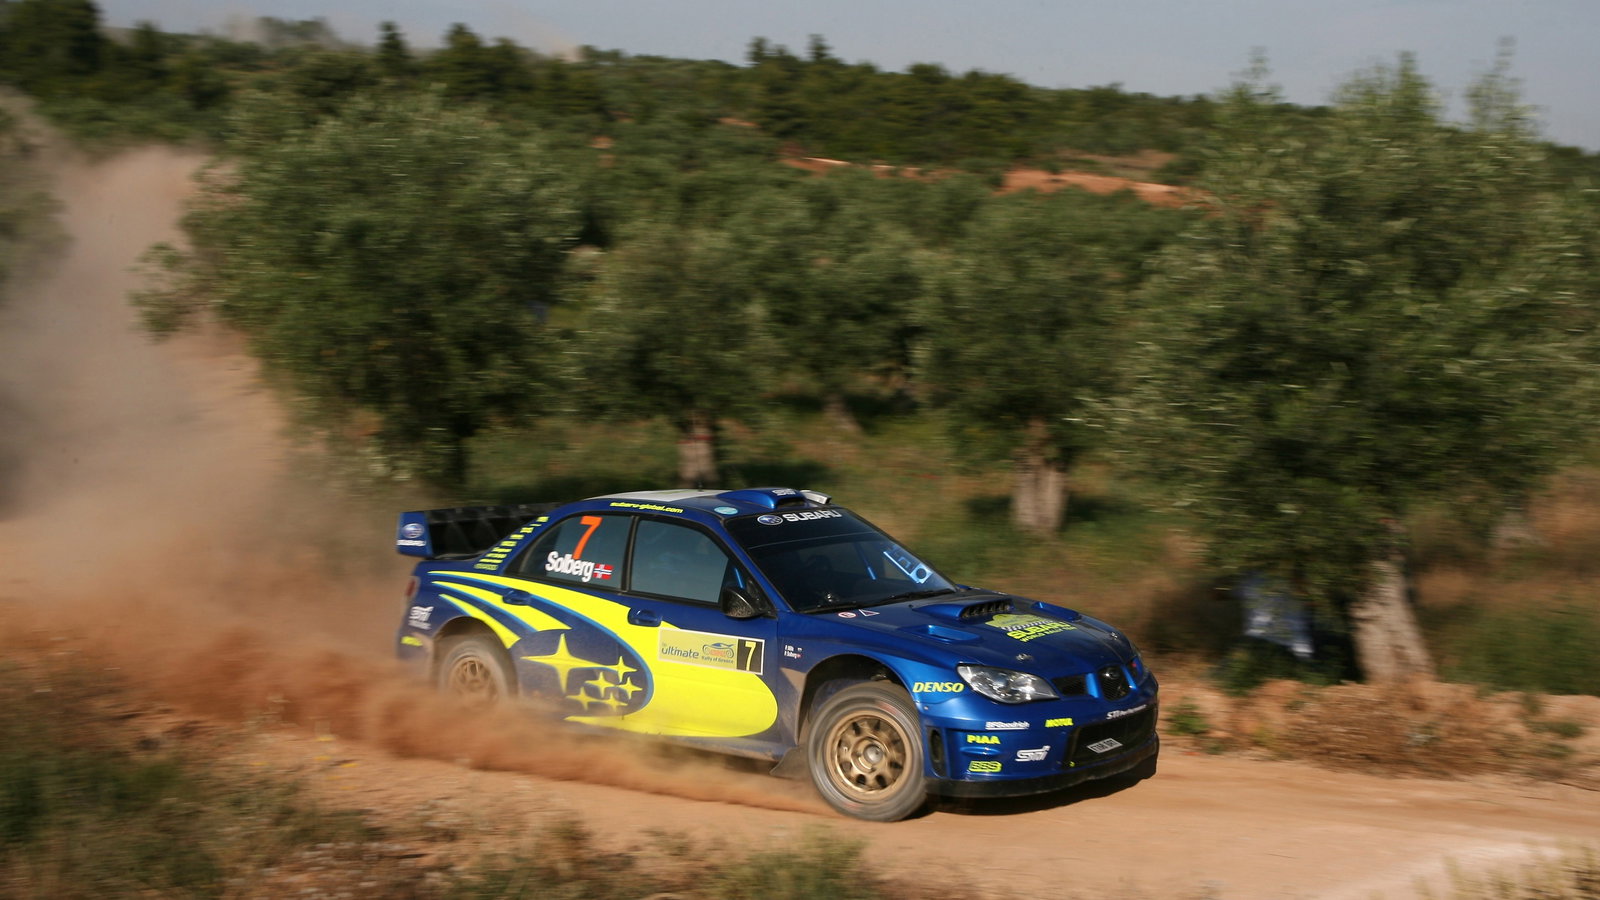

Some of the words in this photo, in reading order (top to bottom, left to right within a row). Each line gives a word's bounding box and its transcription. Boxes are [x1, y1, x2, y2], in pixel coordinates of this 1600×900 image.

[609, 502, 684, 514] subaru-global.com
[782, 509, 843, 523] SUBARU
[573, 516, 603, 560] 7
[545, 551, 595, 582] Solberg
[1006, 621, 1072, 640] SUBARU
[661, 645, 700, 660] ultimate
[744, 640, 757, 671] 7
[912, 682, 965, 694] DENSO
[966, 734, 1001, 745] PIAA
